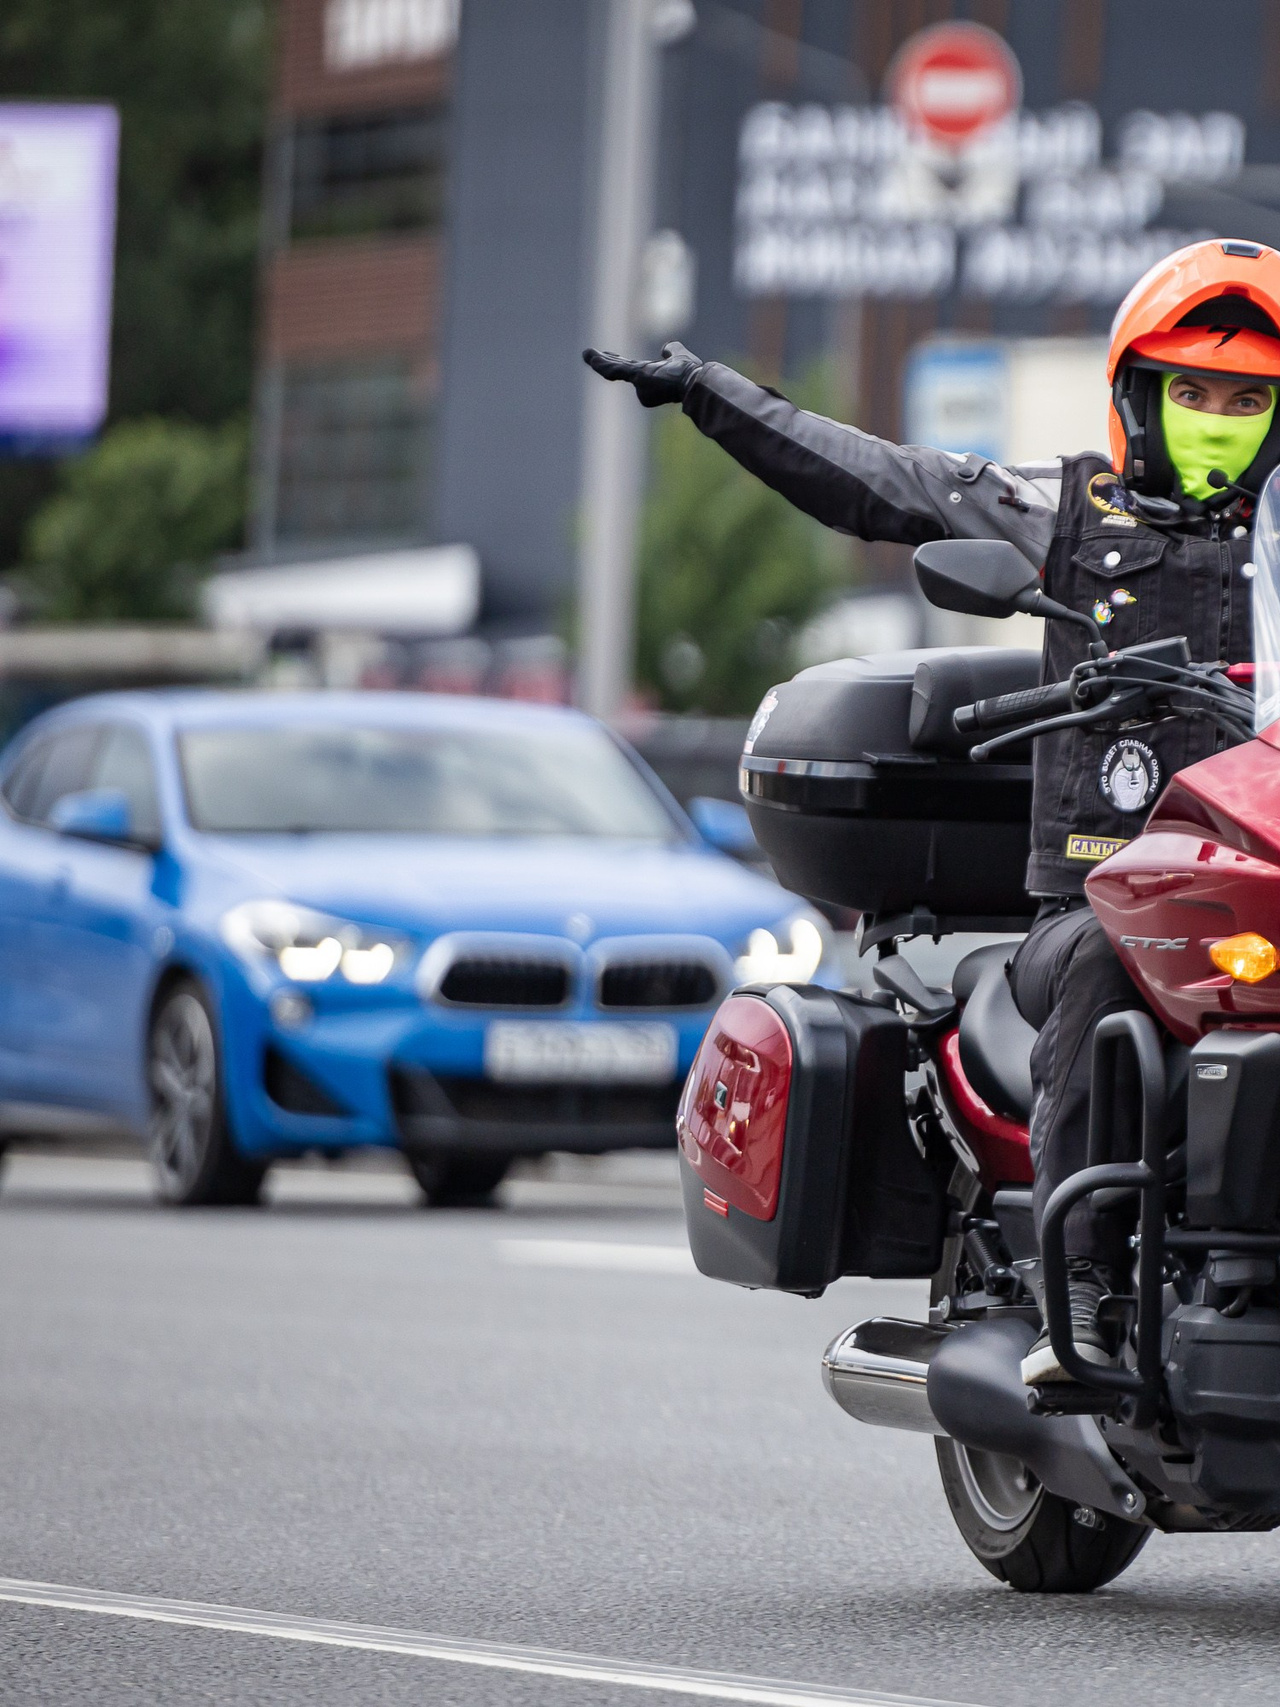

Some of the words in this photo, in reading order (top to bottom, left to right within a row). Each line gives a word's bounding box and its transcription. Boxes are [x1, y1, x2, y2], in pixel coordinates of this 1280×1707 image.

[1101, 744, 1118, 773] БУДЕТ
[1119, 739, 1154, 758] СЛАВНАЯ
[1120, 934, 1190, 950] CTX
